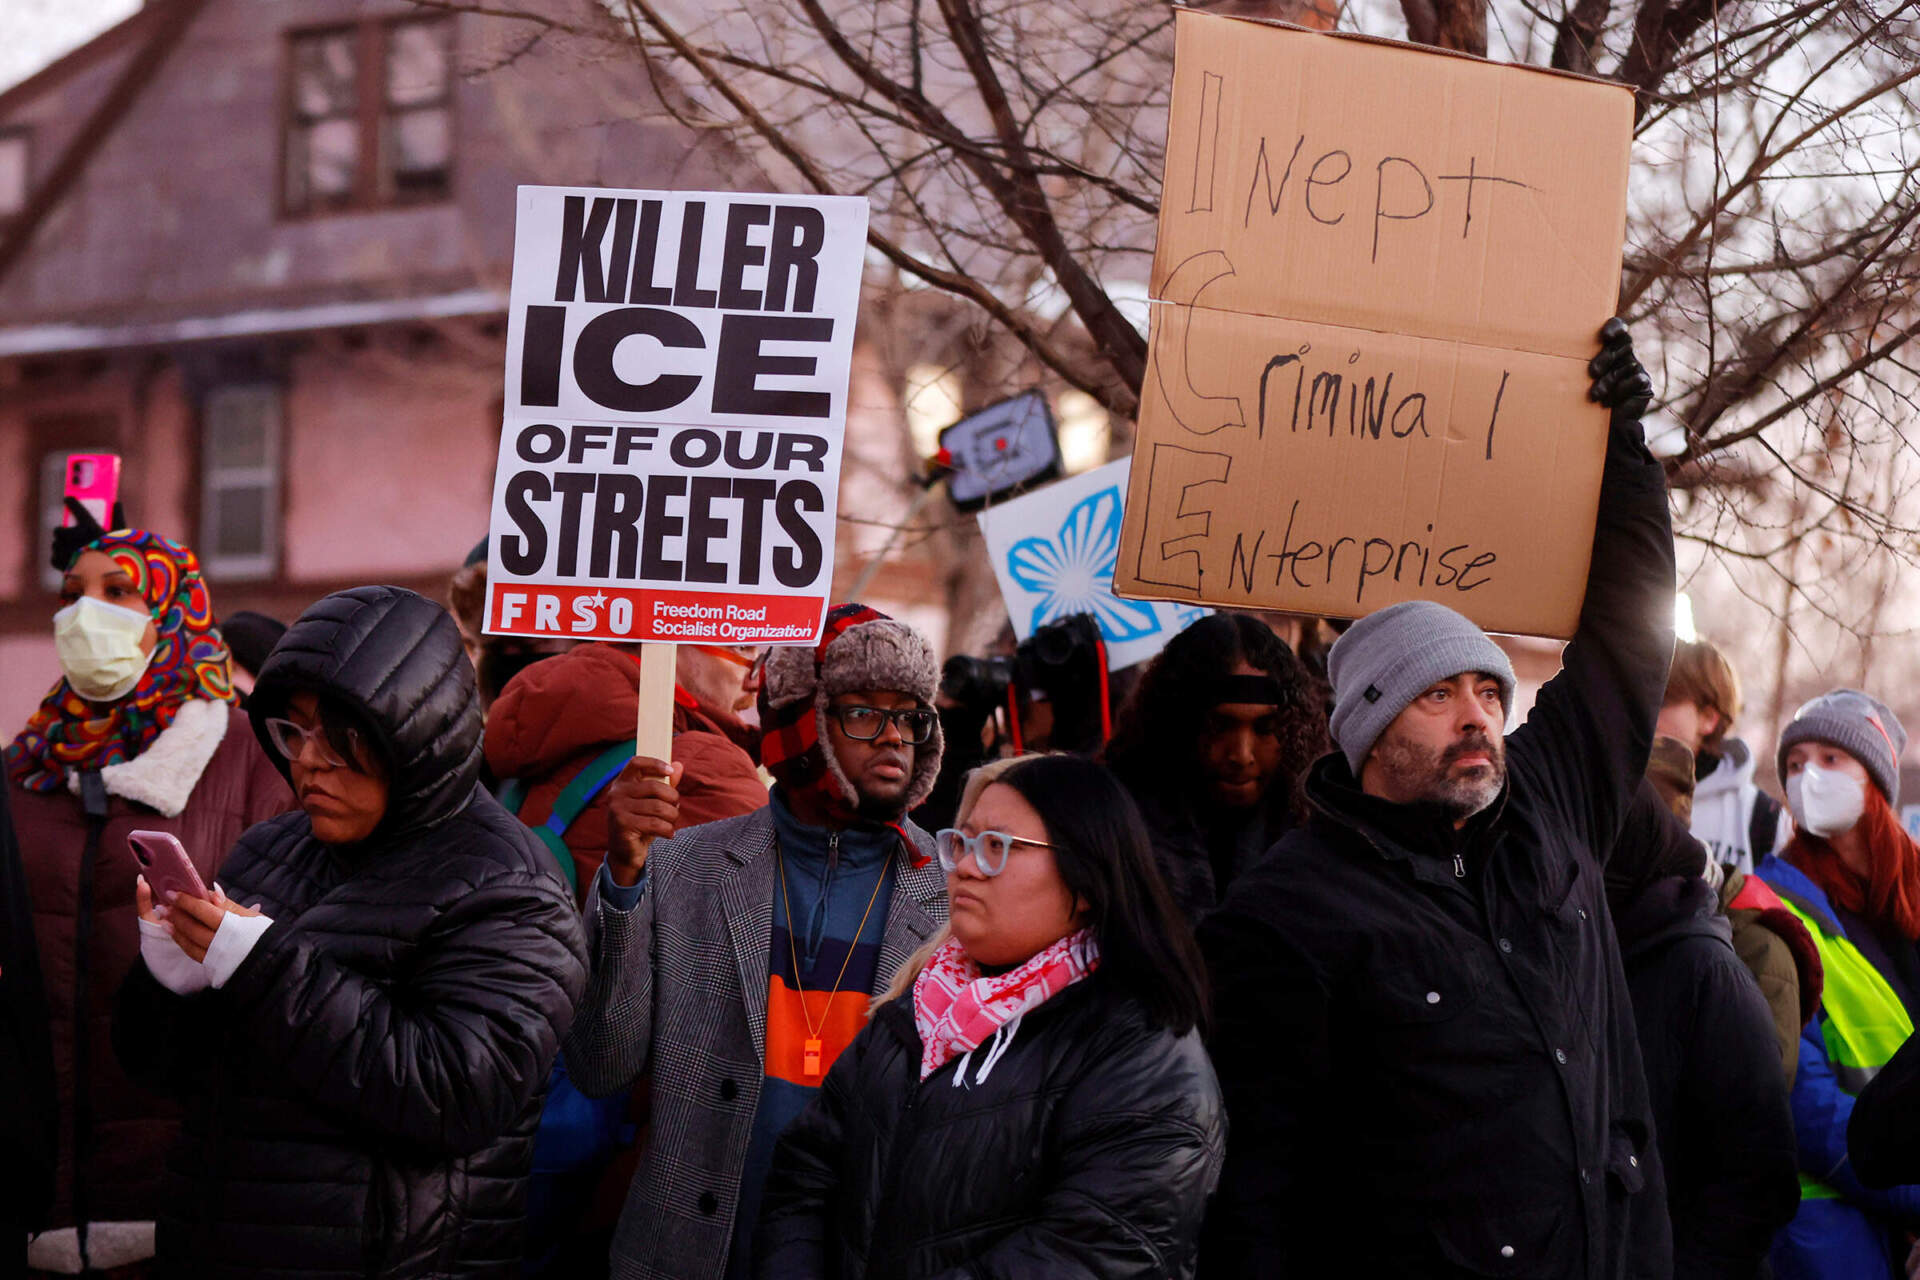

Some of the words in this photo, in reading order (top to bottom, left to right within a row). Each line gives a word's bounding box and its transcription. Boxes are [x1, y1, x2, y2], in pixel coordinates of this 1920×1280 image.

[554, 195, 826, 313] KILLER
[520, 304, 835, 418] ICE
[515, 423, 660, 465] OFF
[669, 428, 829, 472] OUR
[499, 469, 825, 588] STREETS
[500, 591, 634, 635] FRSO
[652, 600, 723, 619] Freedom
[726, 604, 767, 621] Road
[652, 618, 717, 637] Socialist
[719, 622, 813, 640] Organization
